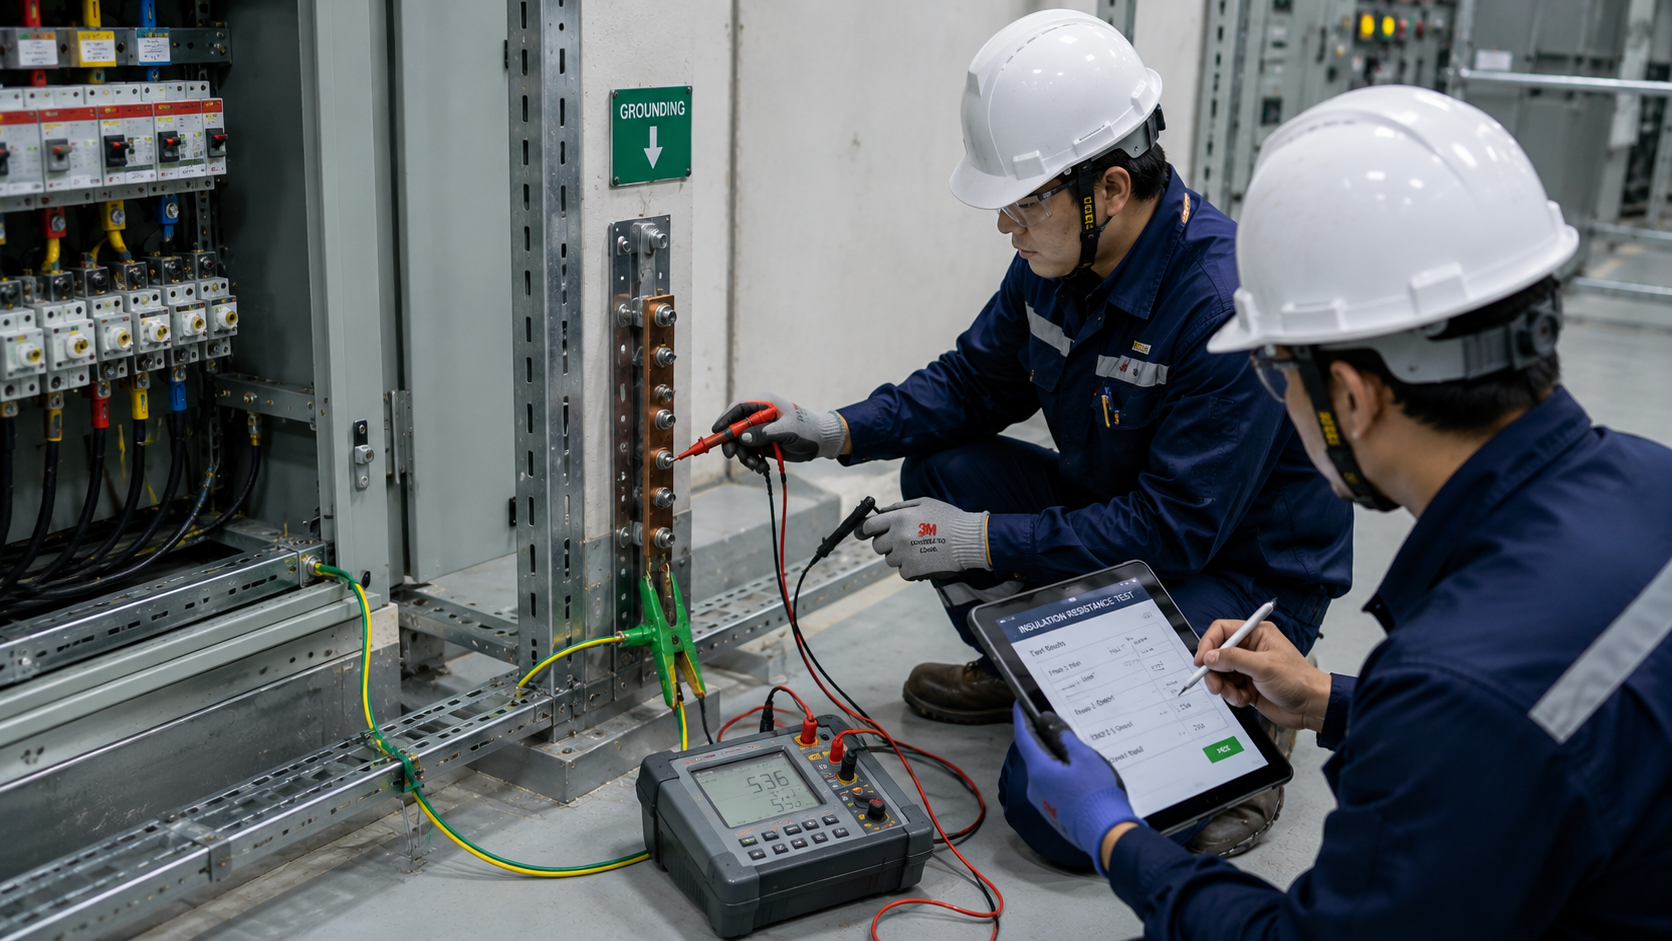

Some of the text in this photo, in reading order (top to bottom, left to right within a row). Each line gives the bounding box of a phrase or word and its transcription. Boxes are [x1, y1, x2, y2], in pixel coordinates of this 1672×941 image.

[620, 101, 685, 119] GROUNDING
[918, 522, 937, 536] 3M
[1018, 612, 1067, 634] INSULATION
[1114, 591, 1135, 603] TEST
[747, 770, 790, 794] 536
